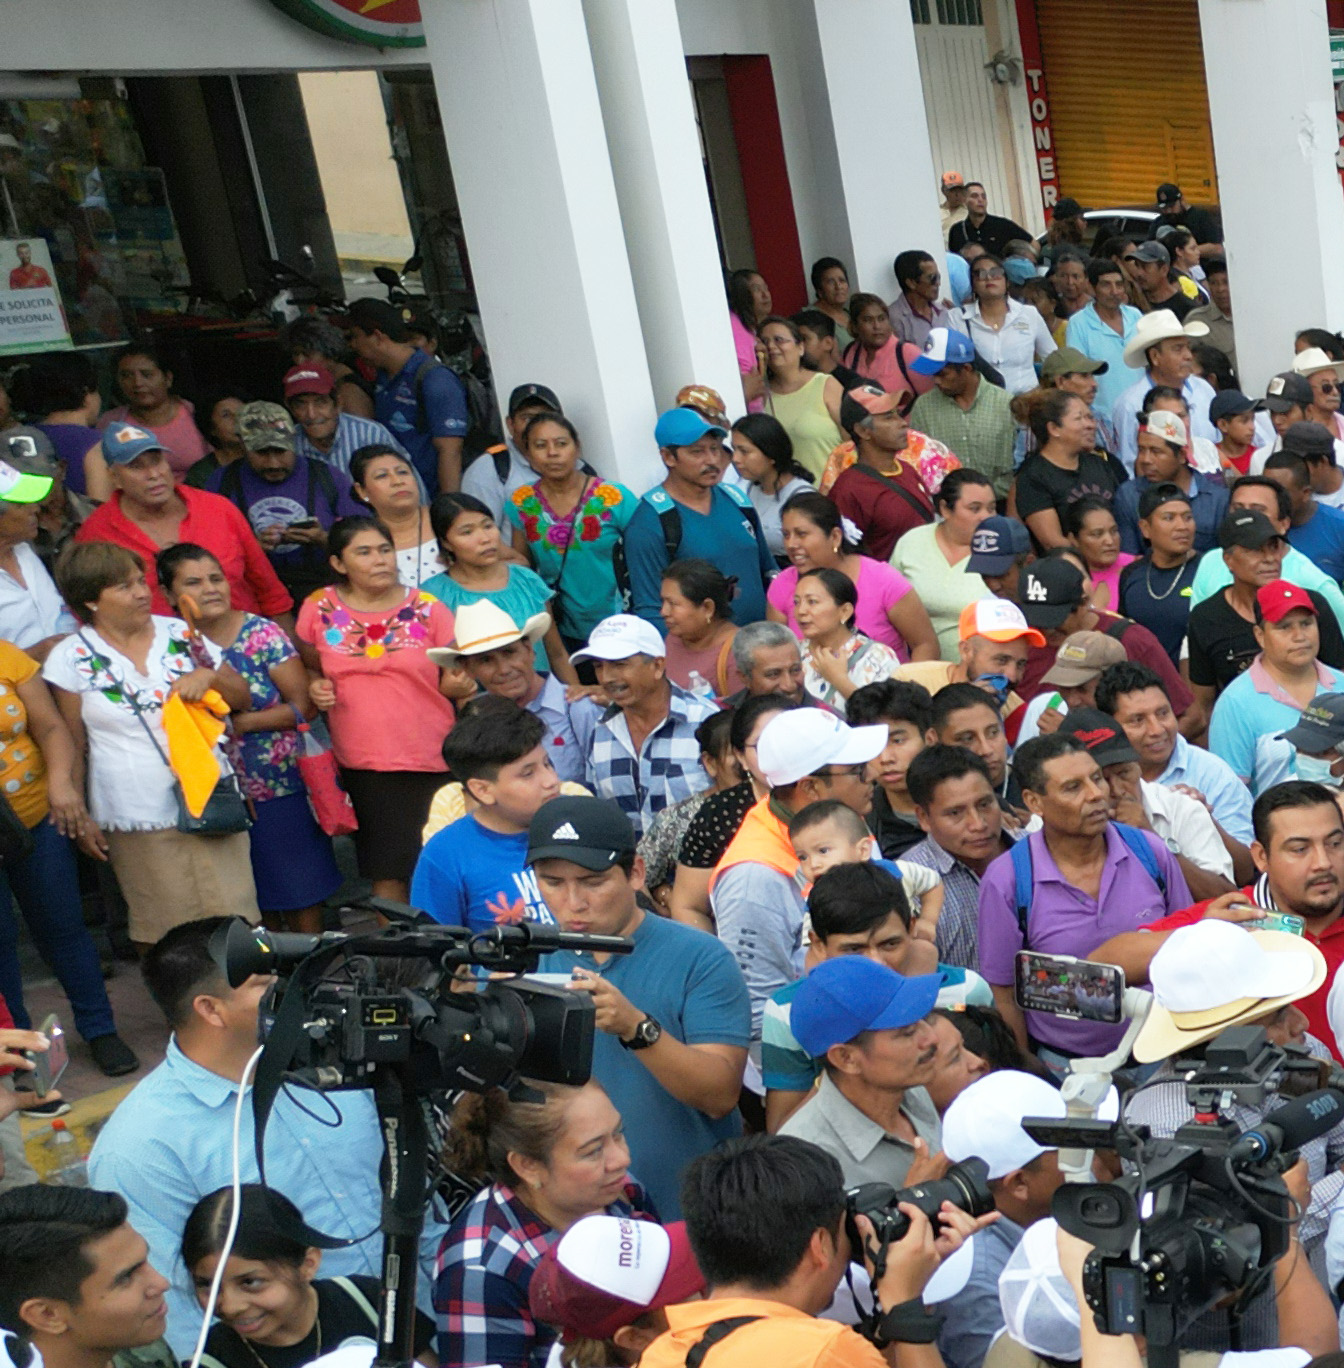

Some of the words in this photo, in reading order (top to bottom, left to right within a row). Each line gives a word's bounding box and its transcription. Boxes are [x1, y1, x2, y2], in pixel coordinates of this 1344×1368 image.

[1026, 68, 1058, 209] TONER
[7, 297, 54, 312] SOLICITA
[0, 312, 56, 326] PERSONAL
